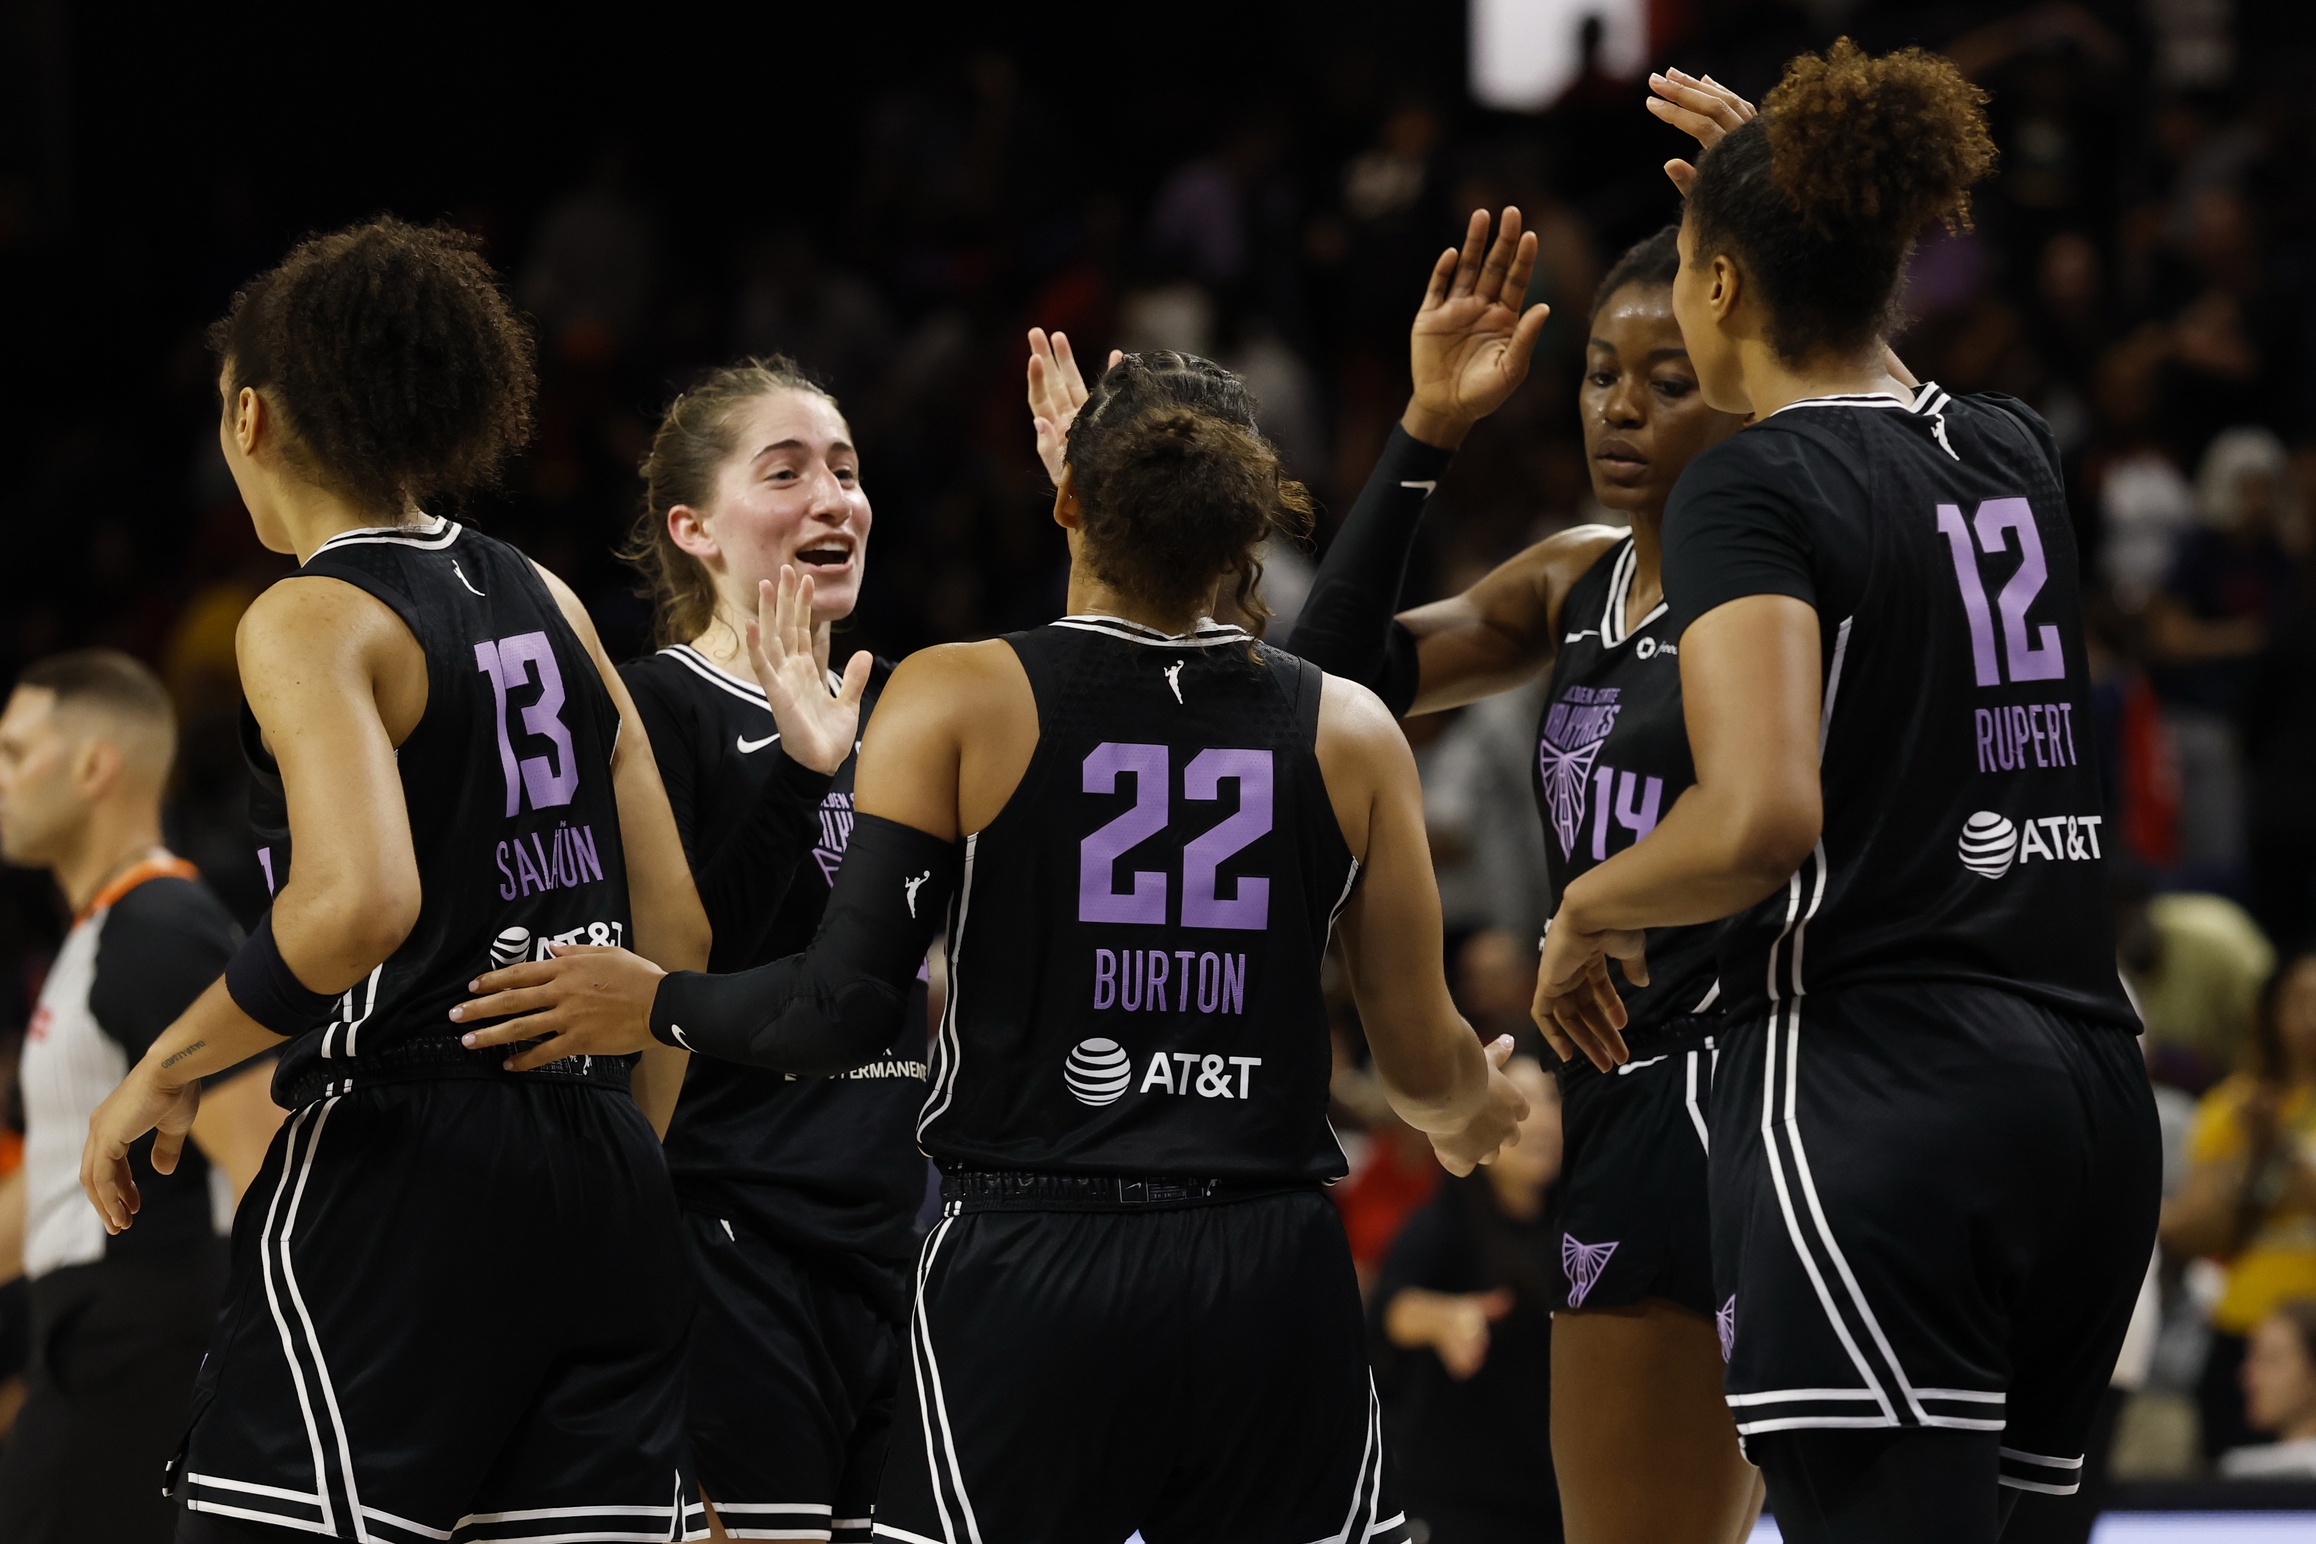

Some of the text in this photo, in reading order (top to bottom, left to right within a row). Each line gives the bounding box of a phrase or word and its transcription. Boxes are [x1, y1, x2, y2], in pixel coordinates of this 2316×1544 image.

[1936, 496, 2066, 687] 12
[473, 630, 579, 818] 13
[1974, 702, 2077, 773] RUPERT
[1078, 741, 1274, 931] 22
[1592, 764, 1664, 861] 14
[2019, 815, 2102, 864] AT&T
[1093, 948, 1246, 1015] BURTON
[1139, 1051, 1262, 1099] AT&T
